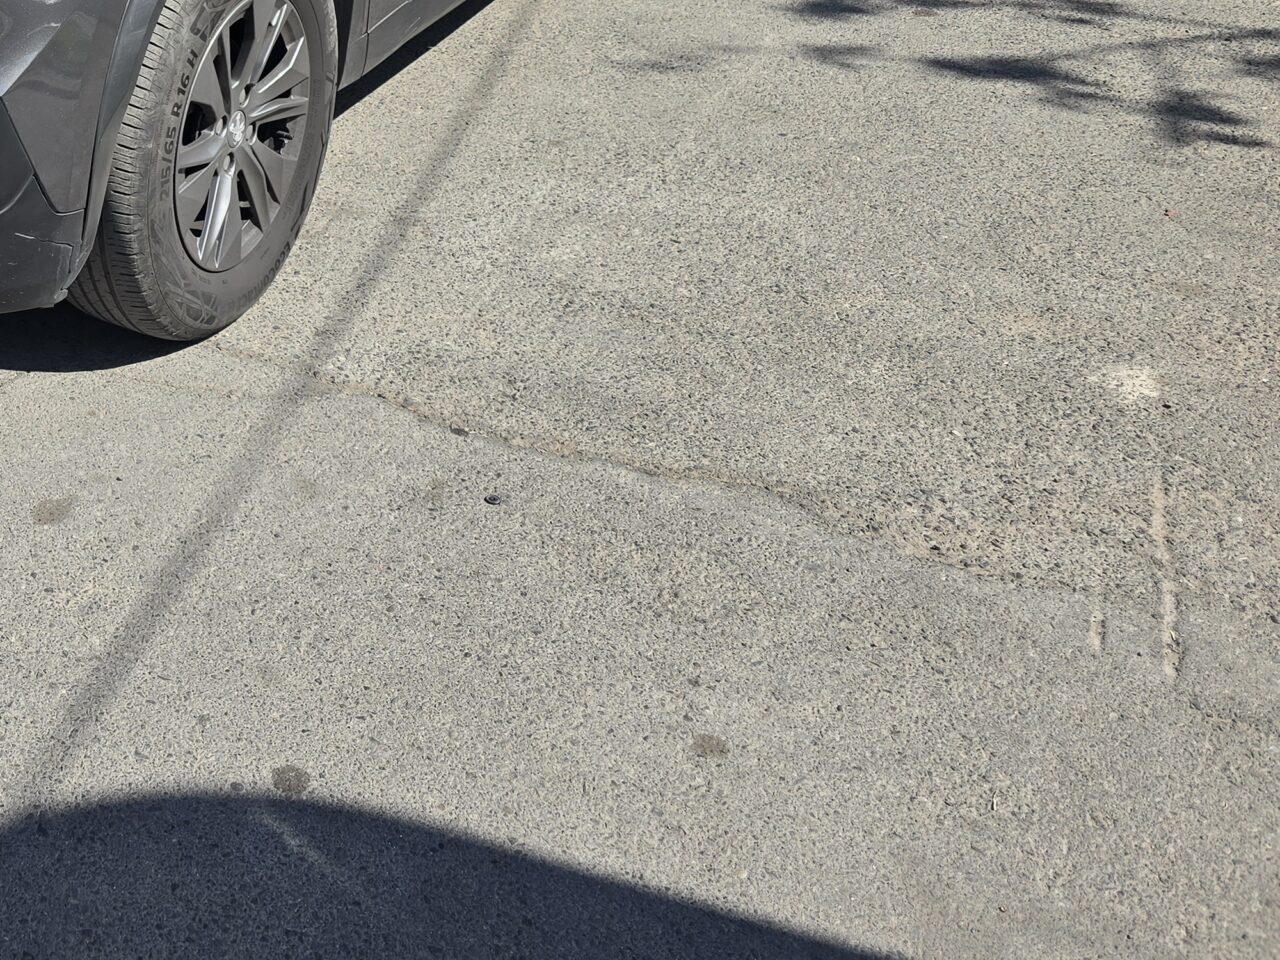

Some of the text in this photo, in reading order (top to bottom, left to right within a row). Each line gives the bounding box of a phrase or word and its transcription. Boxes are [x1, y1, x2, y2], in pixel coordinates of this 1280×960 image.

[160, 48, 198, 202] 215/65 R 16 H
